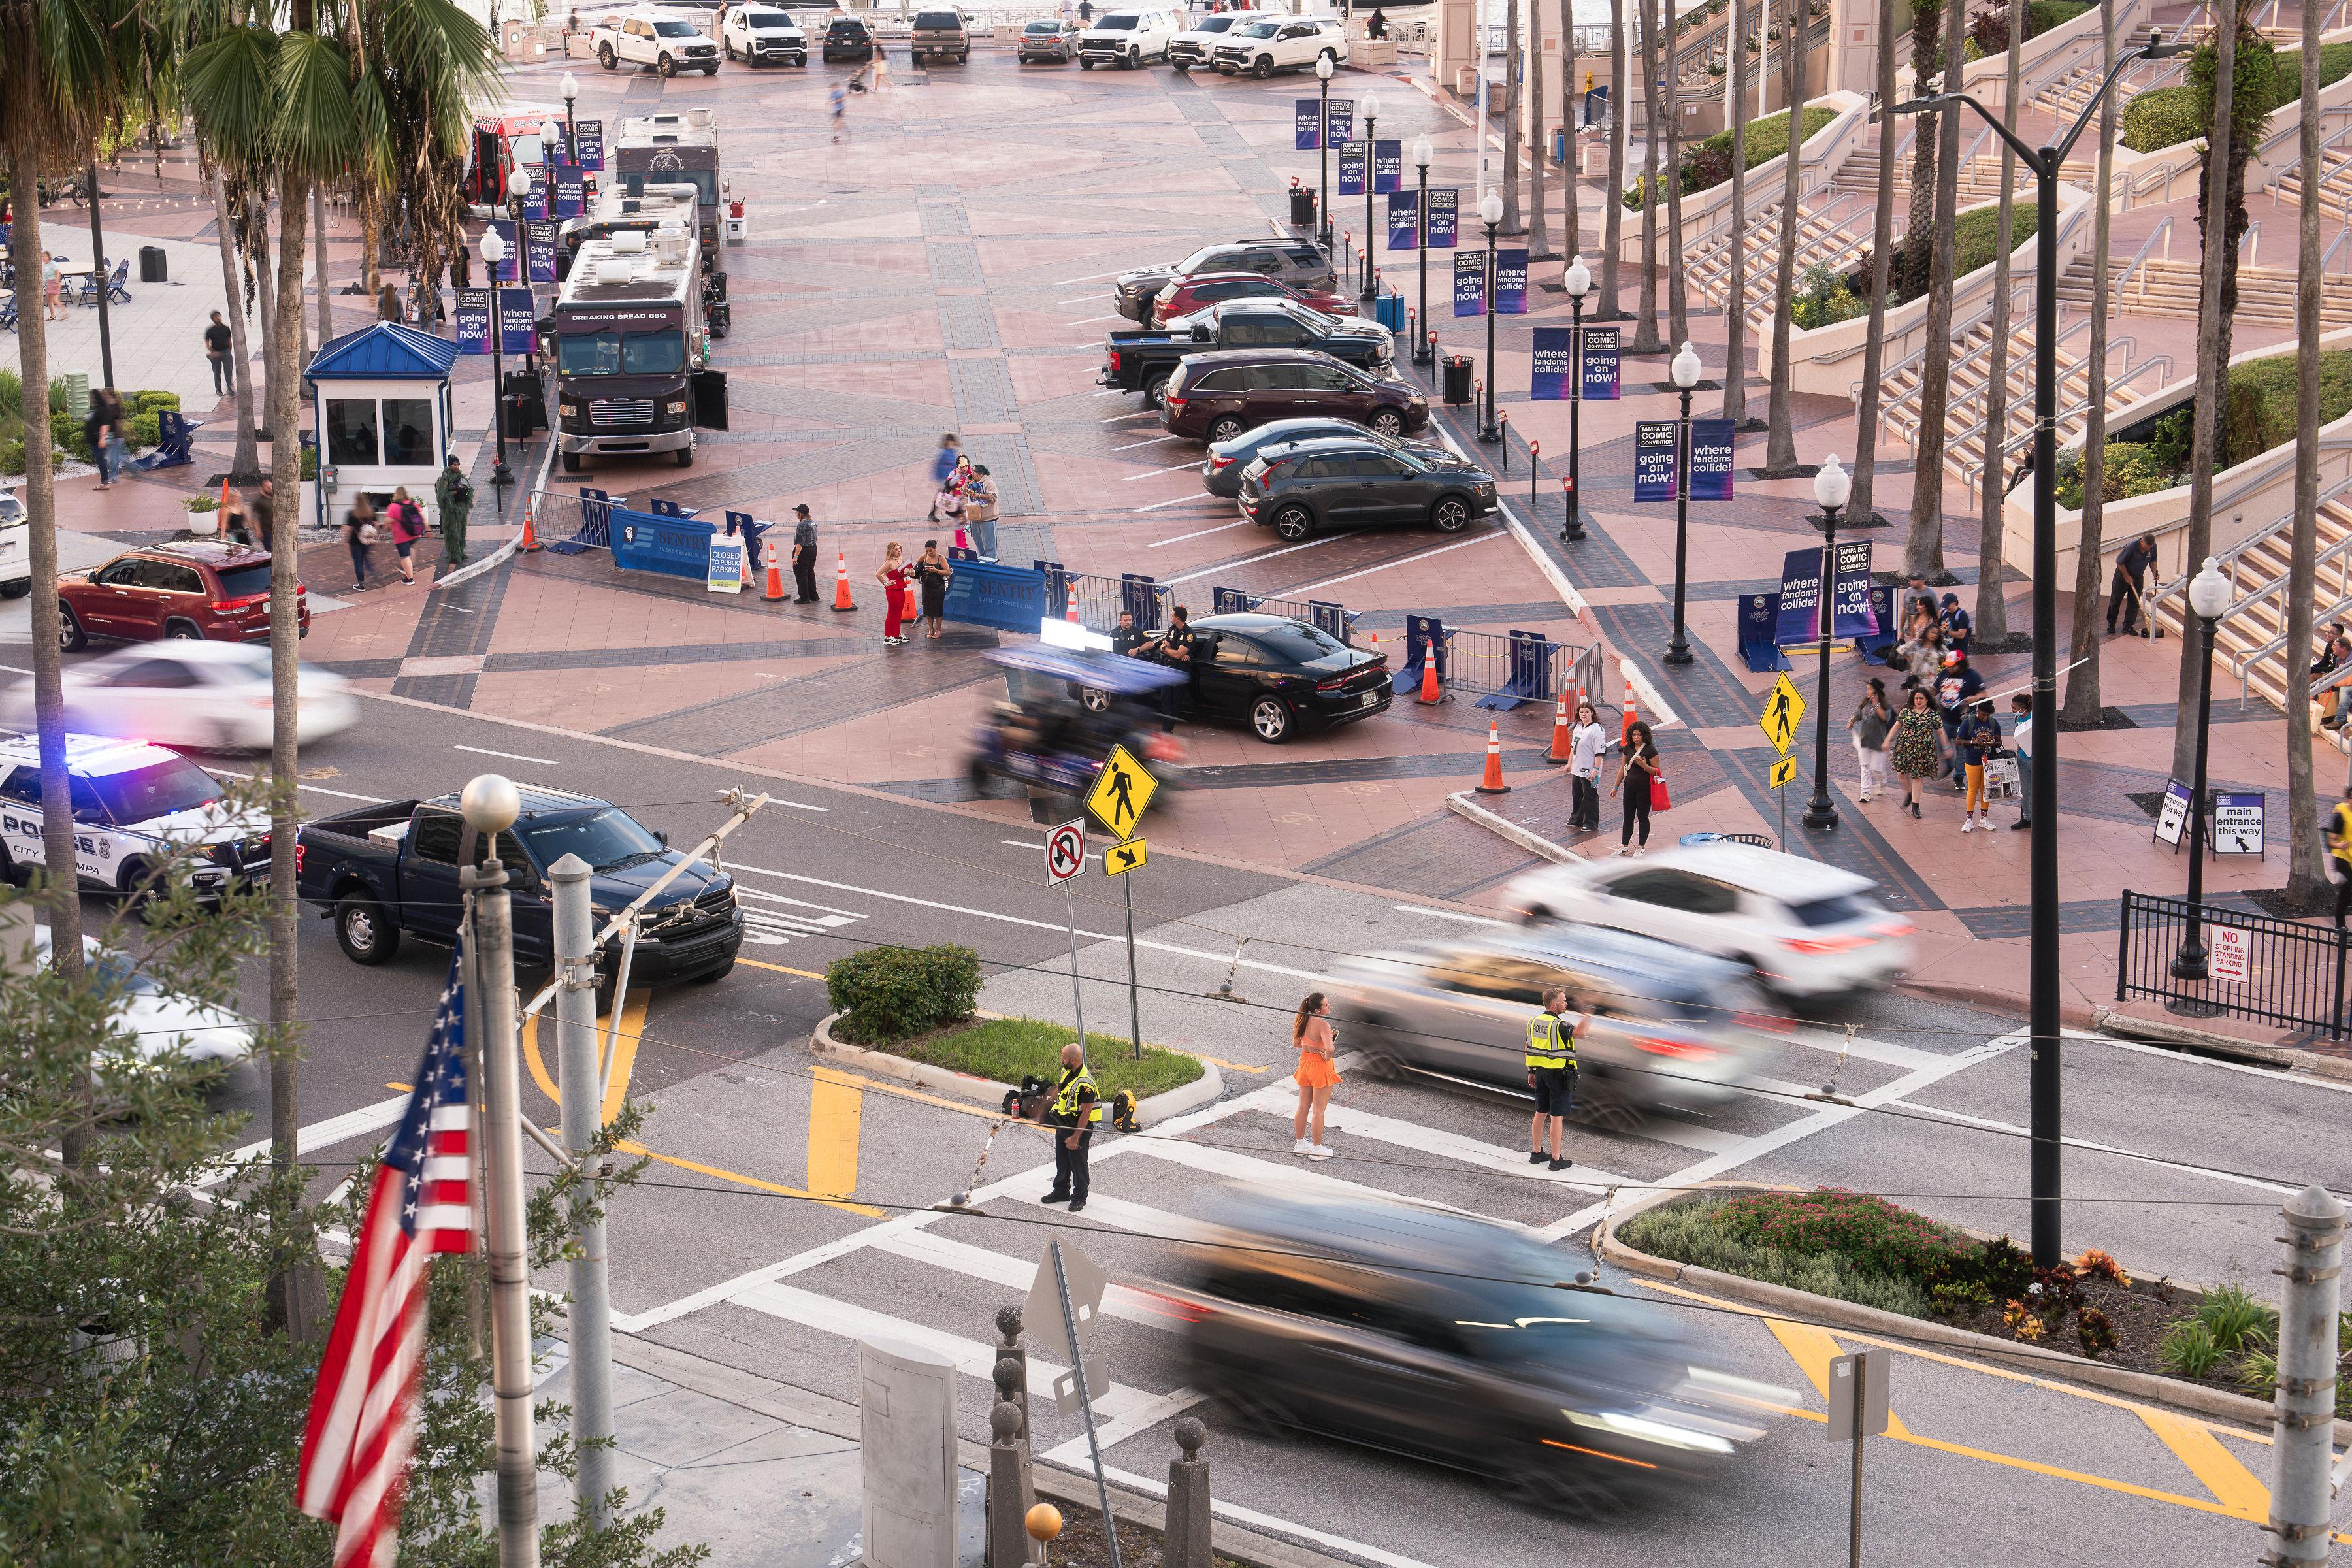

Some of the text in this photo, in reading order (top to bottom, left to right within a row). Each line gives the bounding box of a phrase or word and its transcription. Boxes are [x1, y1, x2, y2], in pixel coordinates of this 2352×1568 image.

[1342, 174, 1364, 182] now!
[531, 246, 553, 255] going
[1498, 269, 1526, 277] where
[1457, 276, 1482, 286] going
[1457, 290, 1482, 301] now!
[460, 314, 487, 323] going
[503, 309, 532, 318] where
[460, 329, 487, 338] now!
[1535, 350, 1567, 358] where
[1586, 356, 1616, 366] going
[1586, 372, 1616, 382] now!
[1694, 445, 1731, 455] where
[1639, 453, 1673, 465] going
[1649, 464, 1664, 472] on
[1693, 463, 1731, 472] collide!
[1639, 471, 1673, 483] now!
[659, 531, 708, 551] SENTRY
[676, 550, 698, 559] SERVICES
[1840, 553, 1867, 564] COMIC
[1784, 578, 1818, 591] where
[1838, 579, 1868, 593] going
[979, 580, 1035, 601] SENTRY
[1782, 589, 1818, 600] fandoms
[1849, 591, 1861, 602] on
[998, 600, 1022, 608] SERVICES
[1780, 597, 1817, 610] collide!
[1838, 599, 1870, 614] now!
[2165, 796, 2187, 809] registration
[2163, 802, 2185, 819] this way
[3, 814, 97, 856] POE
[13, 845, 39, 857] CITY
[2222, 931, 2238, 943] NO
[2215, 943, 2244, 953] STOPPING
[2215, 951, 2244, 960] STANDING
[2217, 958, 2242, 968] PARKING
[1533, 1024, 1548, 1034] POLICE
